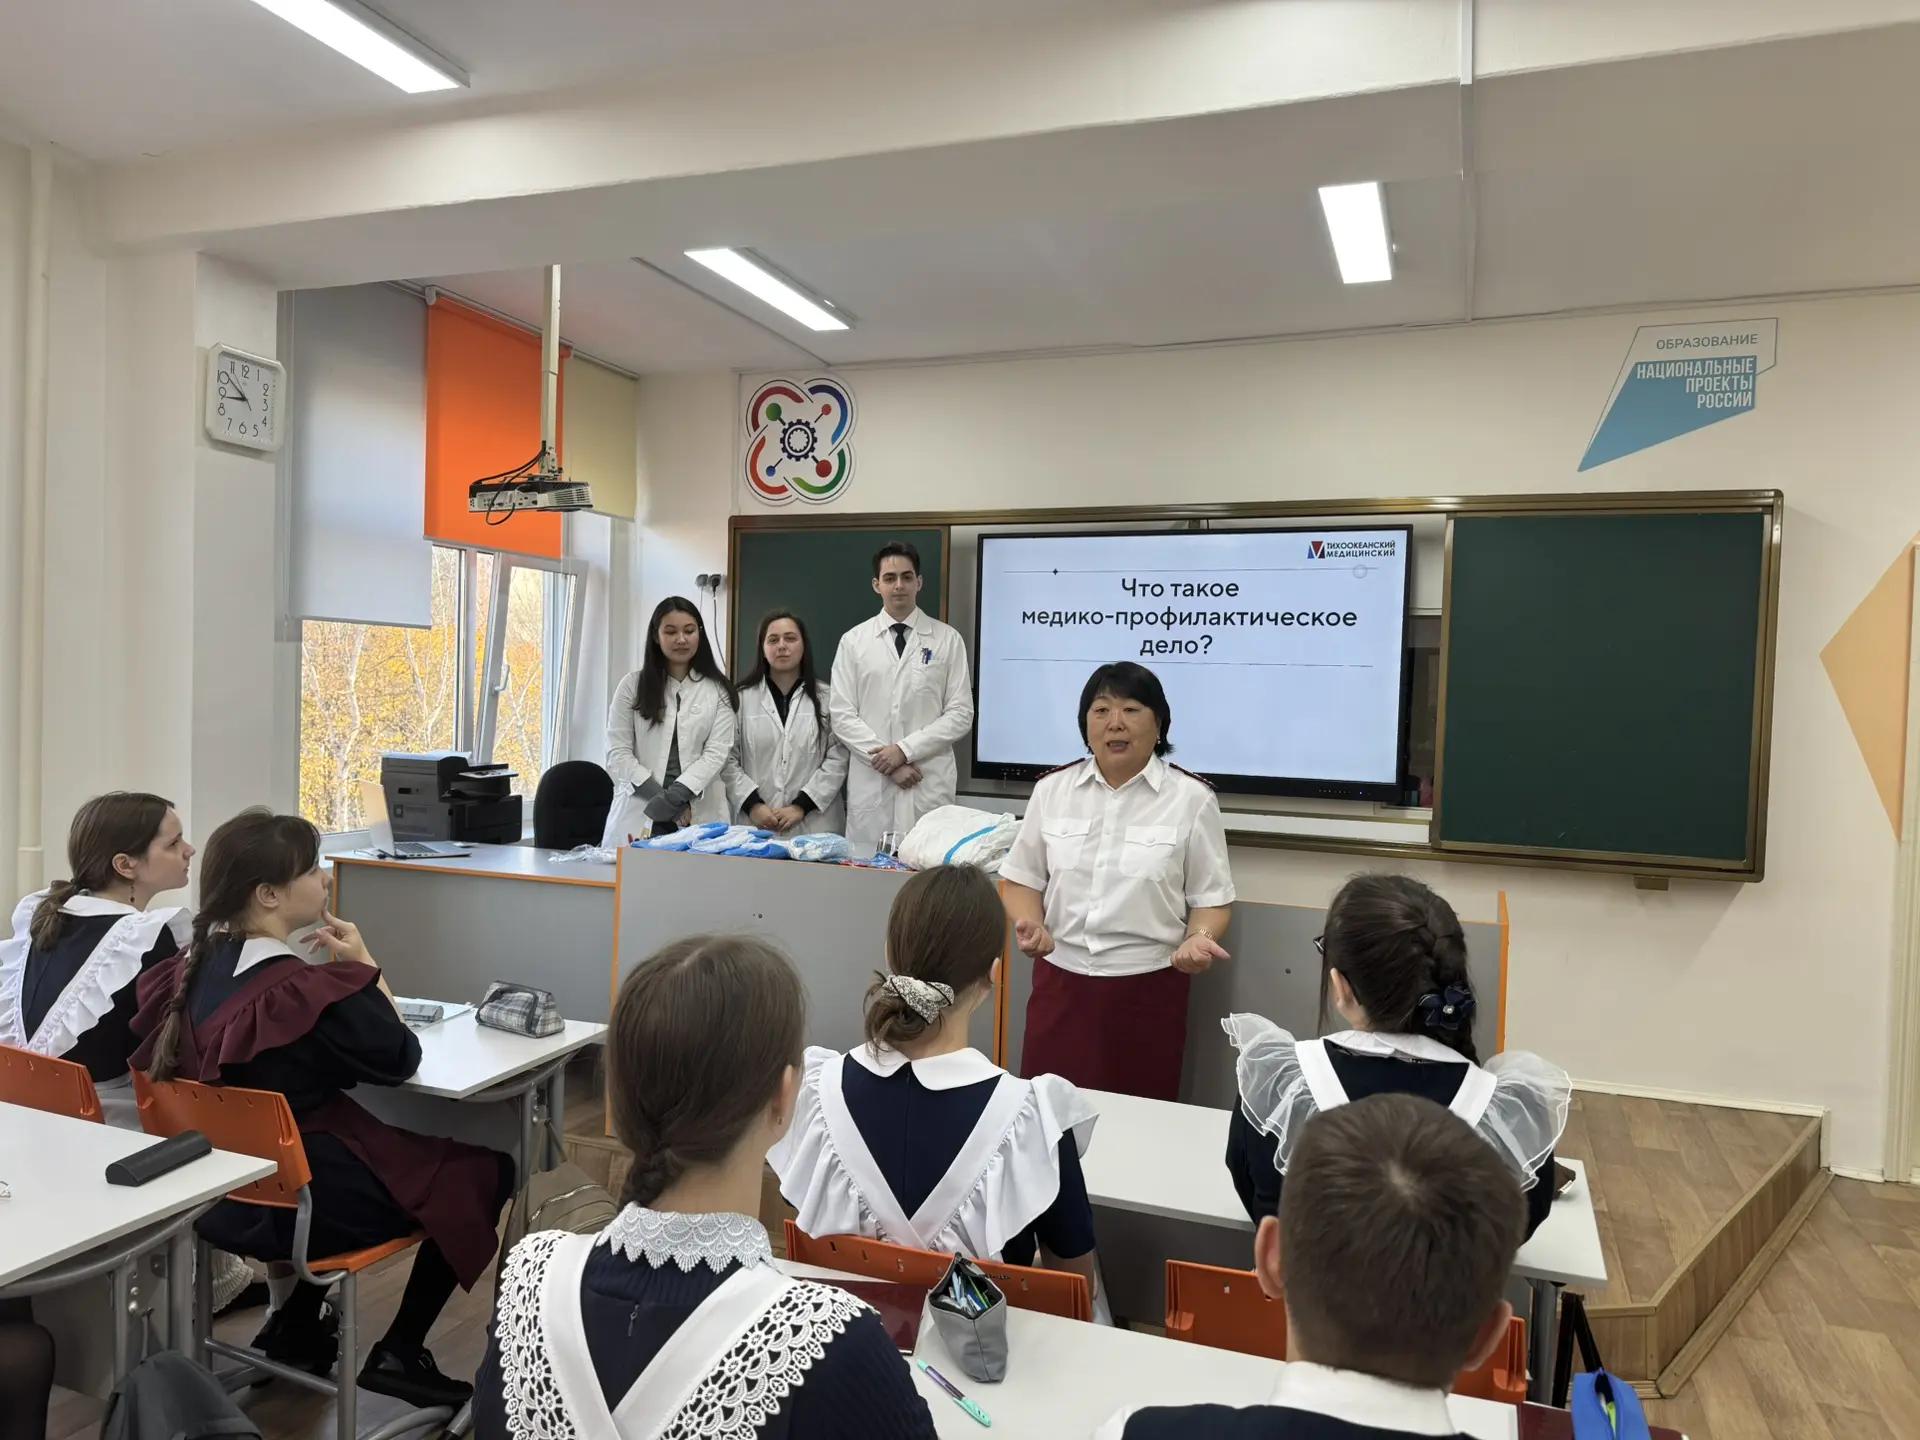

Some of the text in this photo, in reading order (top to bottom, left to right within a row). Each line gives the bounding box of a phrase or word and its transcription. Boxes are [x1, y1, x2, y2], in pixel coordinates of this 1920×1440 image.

[1656, 333, 1759, 350] ОБРАЗОВАНИЕ
[230, 361, 235, 374] 11
[241, 364, 249, 379] 12
[1637, 358, 1754, 379] НАЦИОНАЛЬНЫЕ
[217, 369, 230, 384] 10
[262, 383, 269, 396] 2
[1685, 375, 1753, 393] ПРОЕКТЫ
[219, 387, 226, 400] 9
[1696, 391, 1752, 408] РОССИИ
[217, 402, 226, 416] 8
[262, 399, 268, 411] 3
[227, 417, 232, 430] 7
[239, 421, 246, 434] 6
[262, 415, 267, 427] 4
[253, 424, 258, 437] 5
[1326, 540, 1396, 550] ТИХООКЕАНСКИЙ
[1326, 548, 1395, 558] МЕДИЦИНСКИЙ
[1121, 577, 1240, 598] Что такое
[1021, 605, 1359, 632] медико-профилактическое
[1139, 635, 1214, 657] дело?
